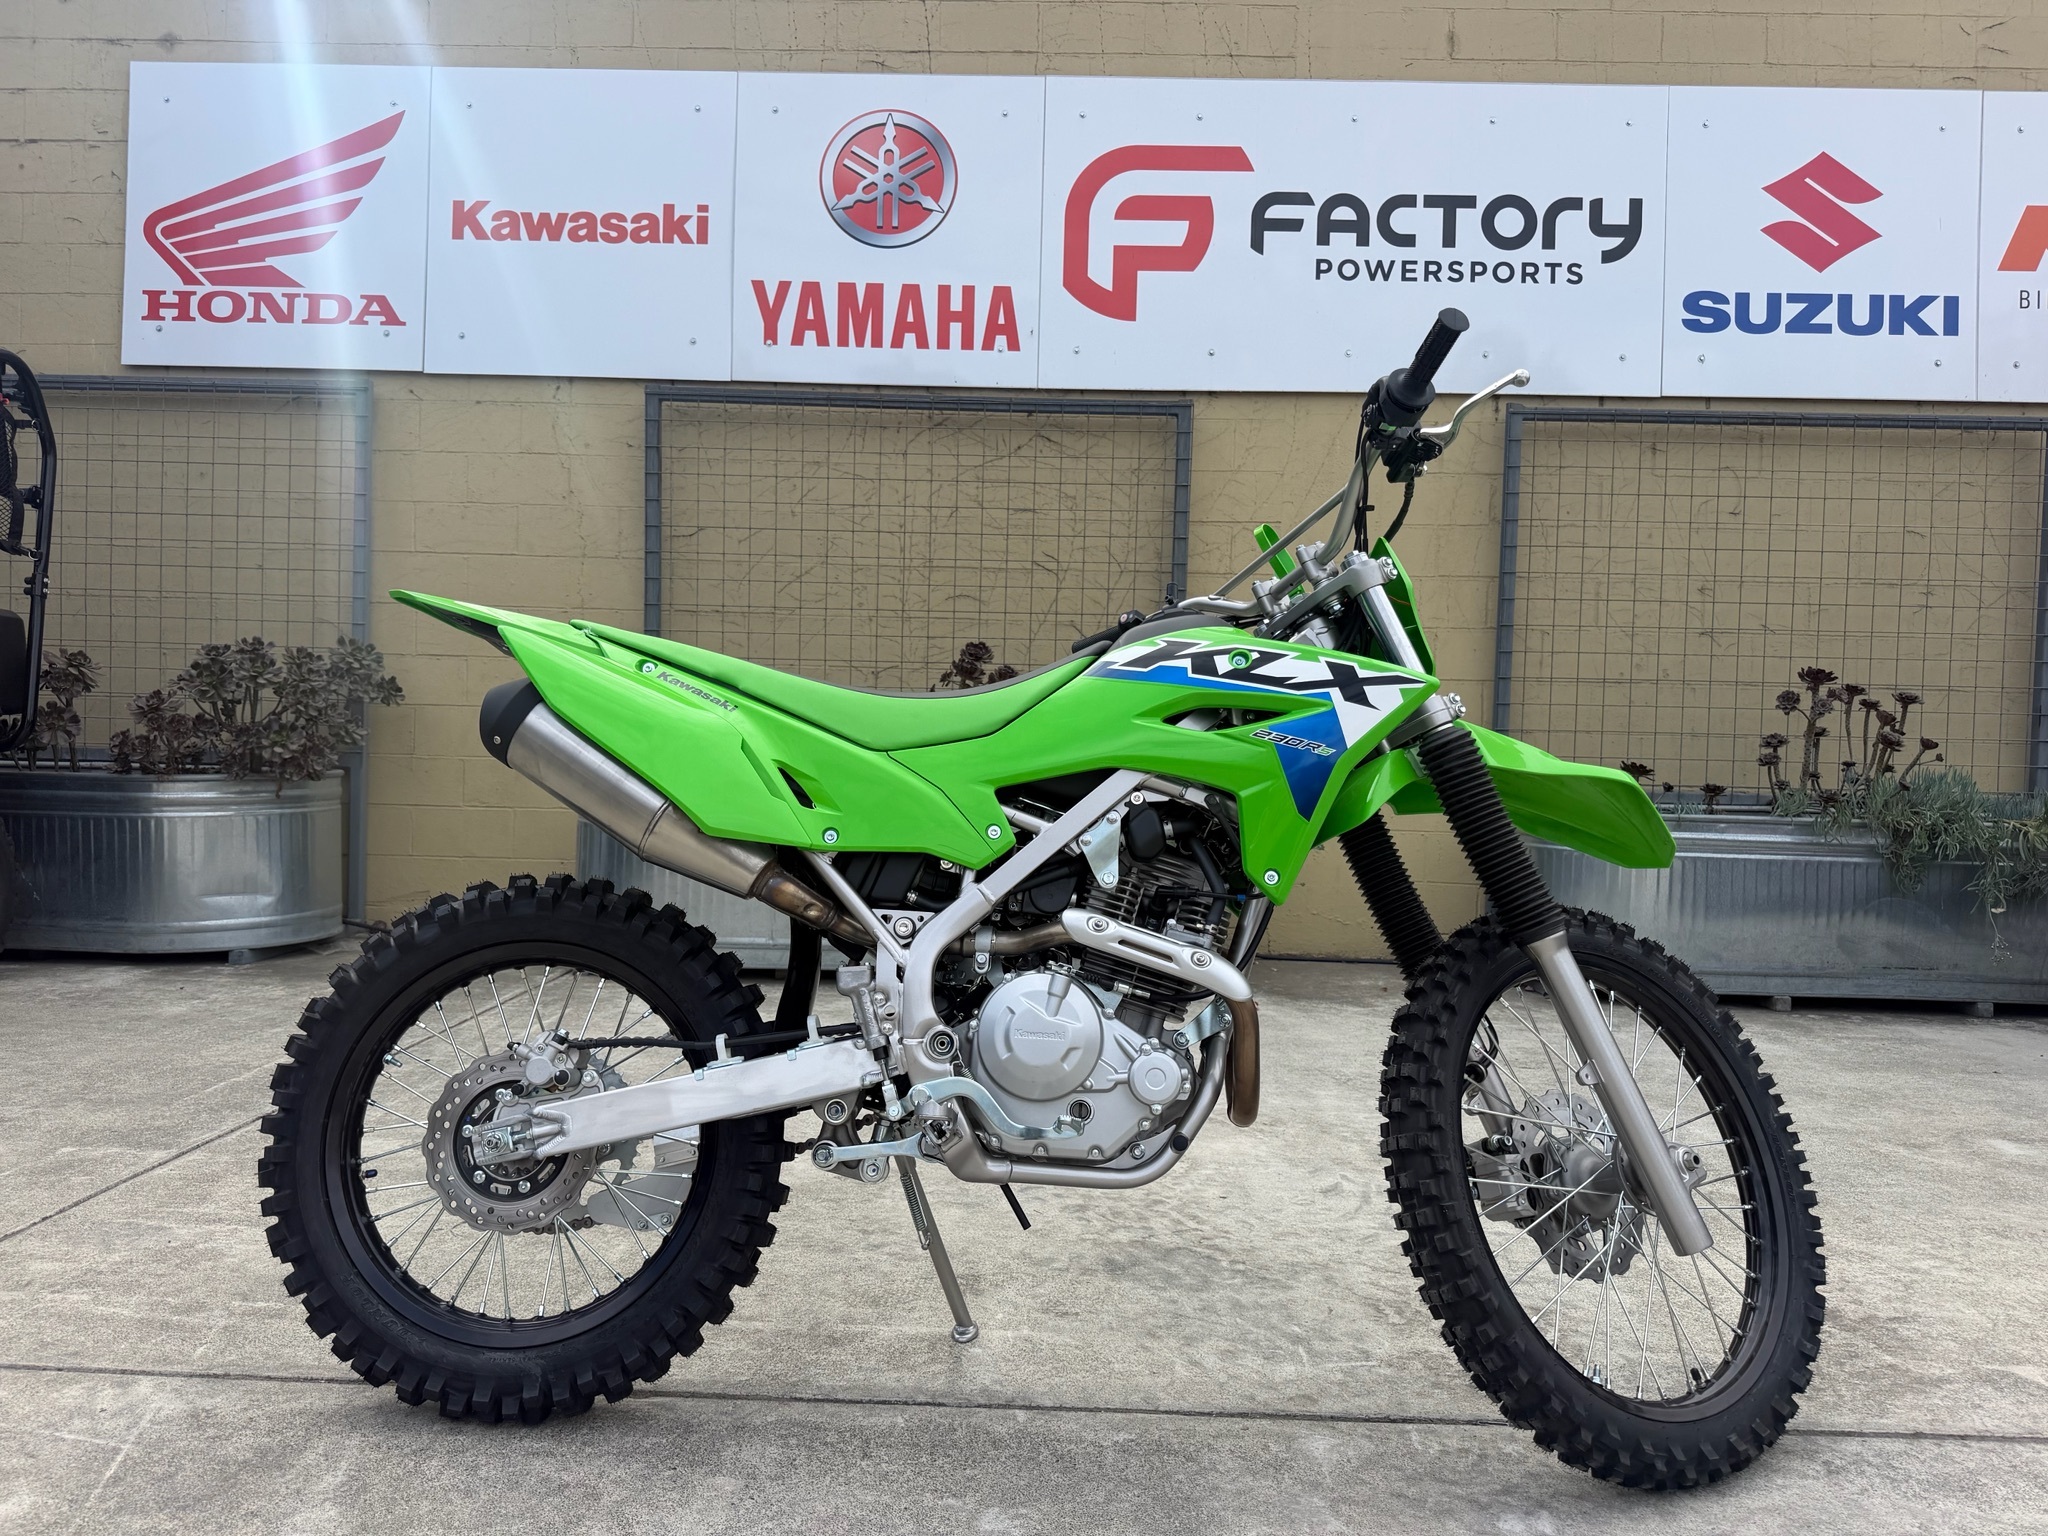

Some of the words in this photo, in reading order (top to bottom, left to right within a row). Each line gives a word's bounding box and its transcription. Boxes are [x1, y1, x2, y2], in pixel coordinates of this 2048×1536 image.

[451, 200, 709, 245] Kawasaki
[1315, 259, 1583, 285] POWERSPORTS
[141, 289, 406, 327] HONDA
[751, 279, 1021, 352] YAMAHA
[1681, 290, 1960, 337] SUZUKI
[2019, 289, 2048, 310] BI
[655, 671, 740, 713] Kawasaki
[1117, 640, 1427, 711] KLX
[1013, 1028, 1067, 1041] Kawasaki
